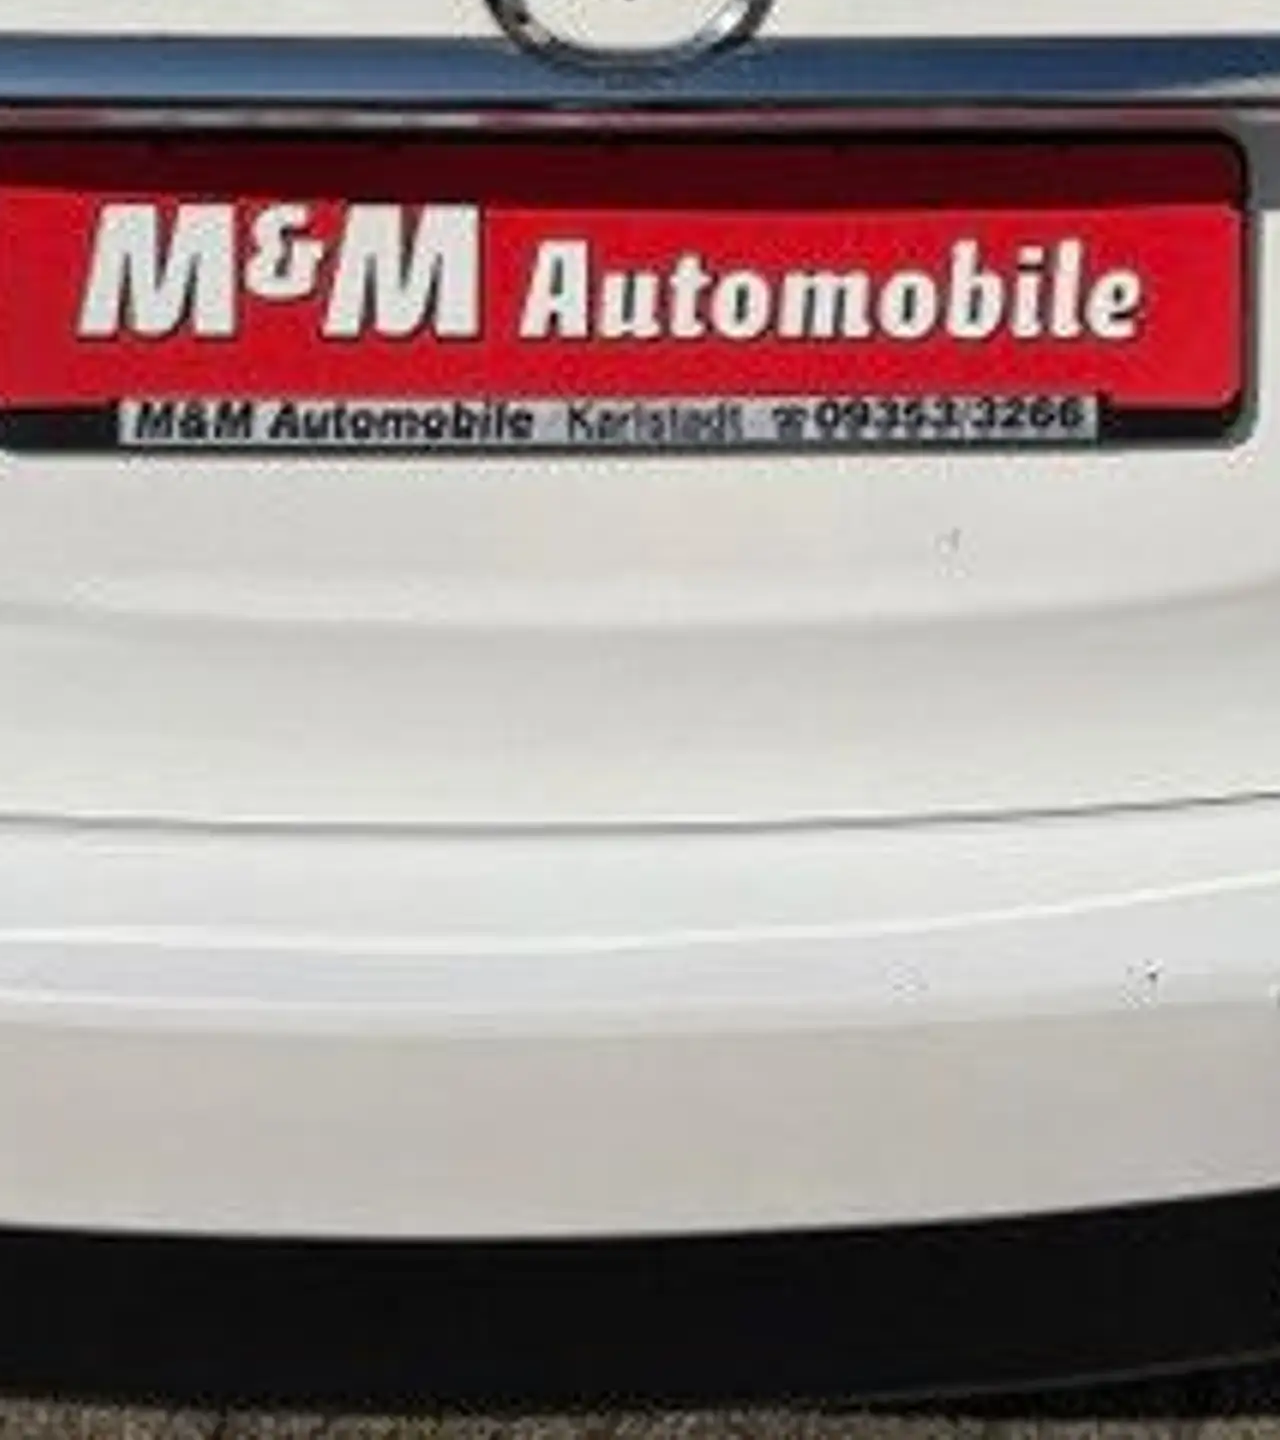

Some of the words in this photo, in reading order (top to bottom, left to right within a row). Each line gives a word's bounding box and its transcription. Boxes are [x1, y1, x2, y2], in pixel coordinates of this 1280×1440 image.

[77, 203, 482, 338] M&M
[520, 240, 1144, 340] Automobile
[135, 400, 254, 439] M&M
[268, 399, 534, 439] Automobile
